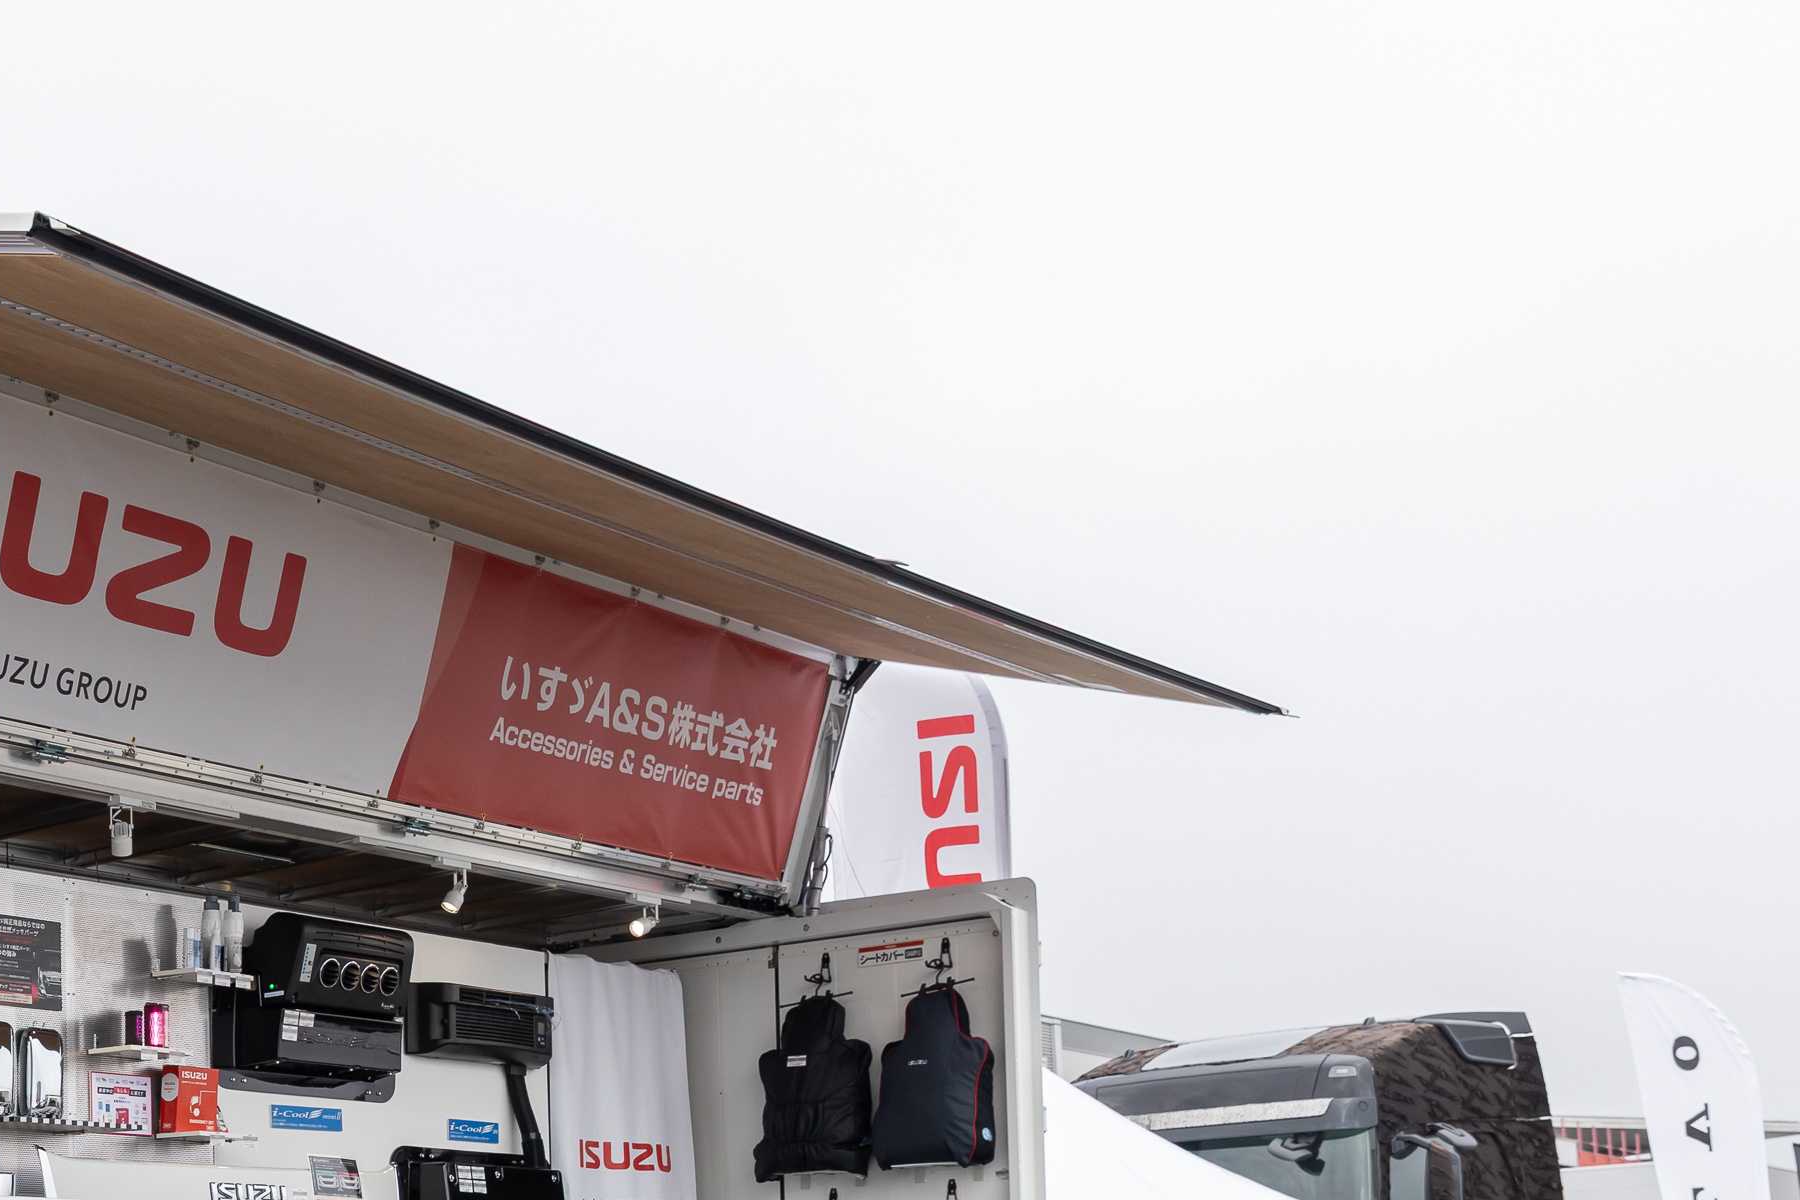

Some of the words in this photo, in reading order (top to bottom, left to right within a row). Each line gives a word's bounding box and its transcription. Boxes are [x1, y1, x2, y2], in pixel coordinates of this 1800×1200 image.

[57, 668, 148, 710] GROUP
[501, 655, 778, 771] いすゞA&S株式会社
[489, 716, 614, 769] Accessories
[618, 748, 636, 775] &
[640, 754, 709, 793] Service
[711, 776, 764, 806] parts
[860, 950, 904, 965] シートカバー
[181, 1070, 208, 1081] ISUZU
[272, 1107, 310, 1120] i-Cool
[449, 1122, 483, 1133] i-Cool
[579, 1139, 671, 1173] ISUZU
